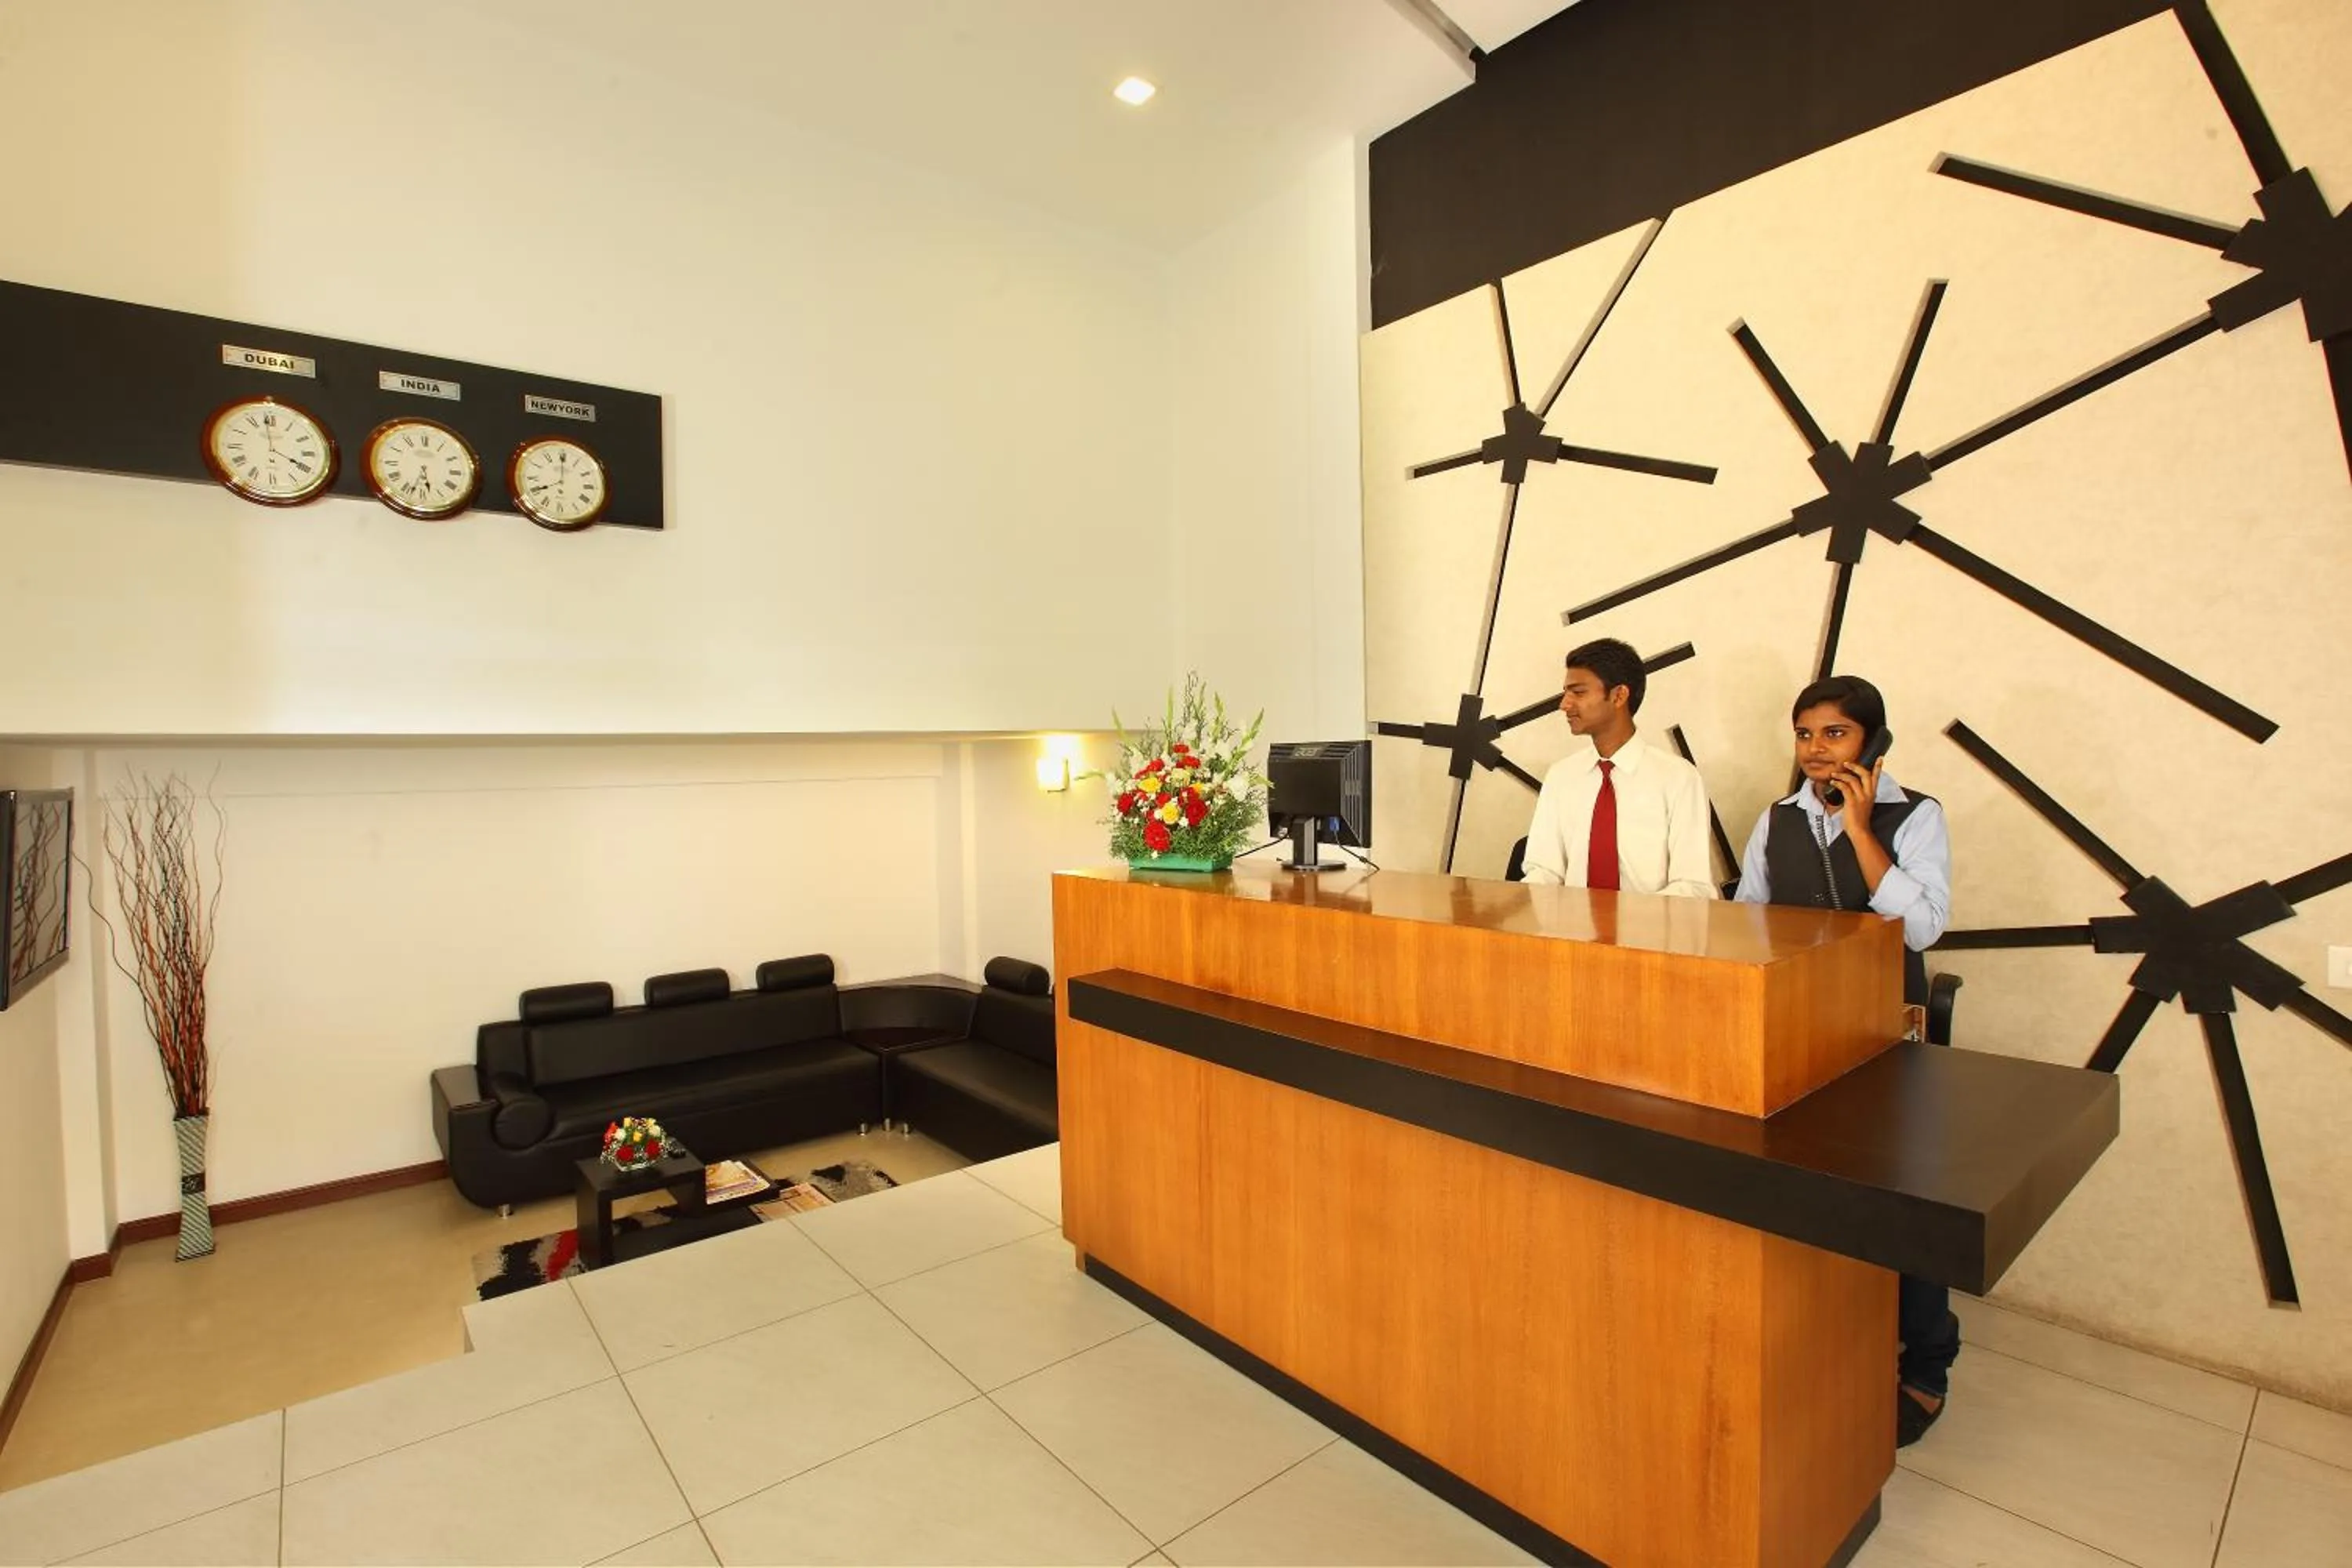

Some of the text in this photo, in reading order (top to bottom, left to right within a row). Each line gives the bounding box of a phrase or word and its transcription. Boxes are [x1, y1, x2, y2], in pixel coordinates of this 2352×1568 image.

[245, 354, 294, 369] DUBAI
[401, 379, 440, 393] INDIA
[531, 401, 590, 416] NEWYORK
